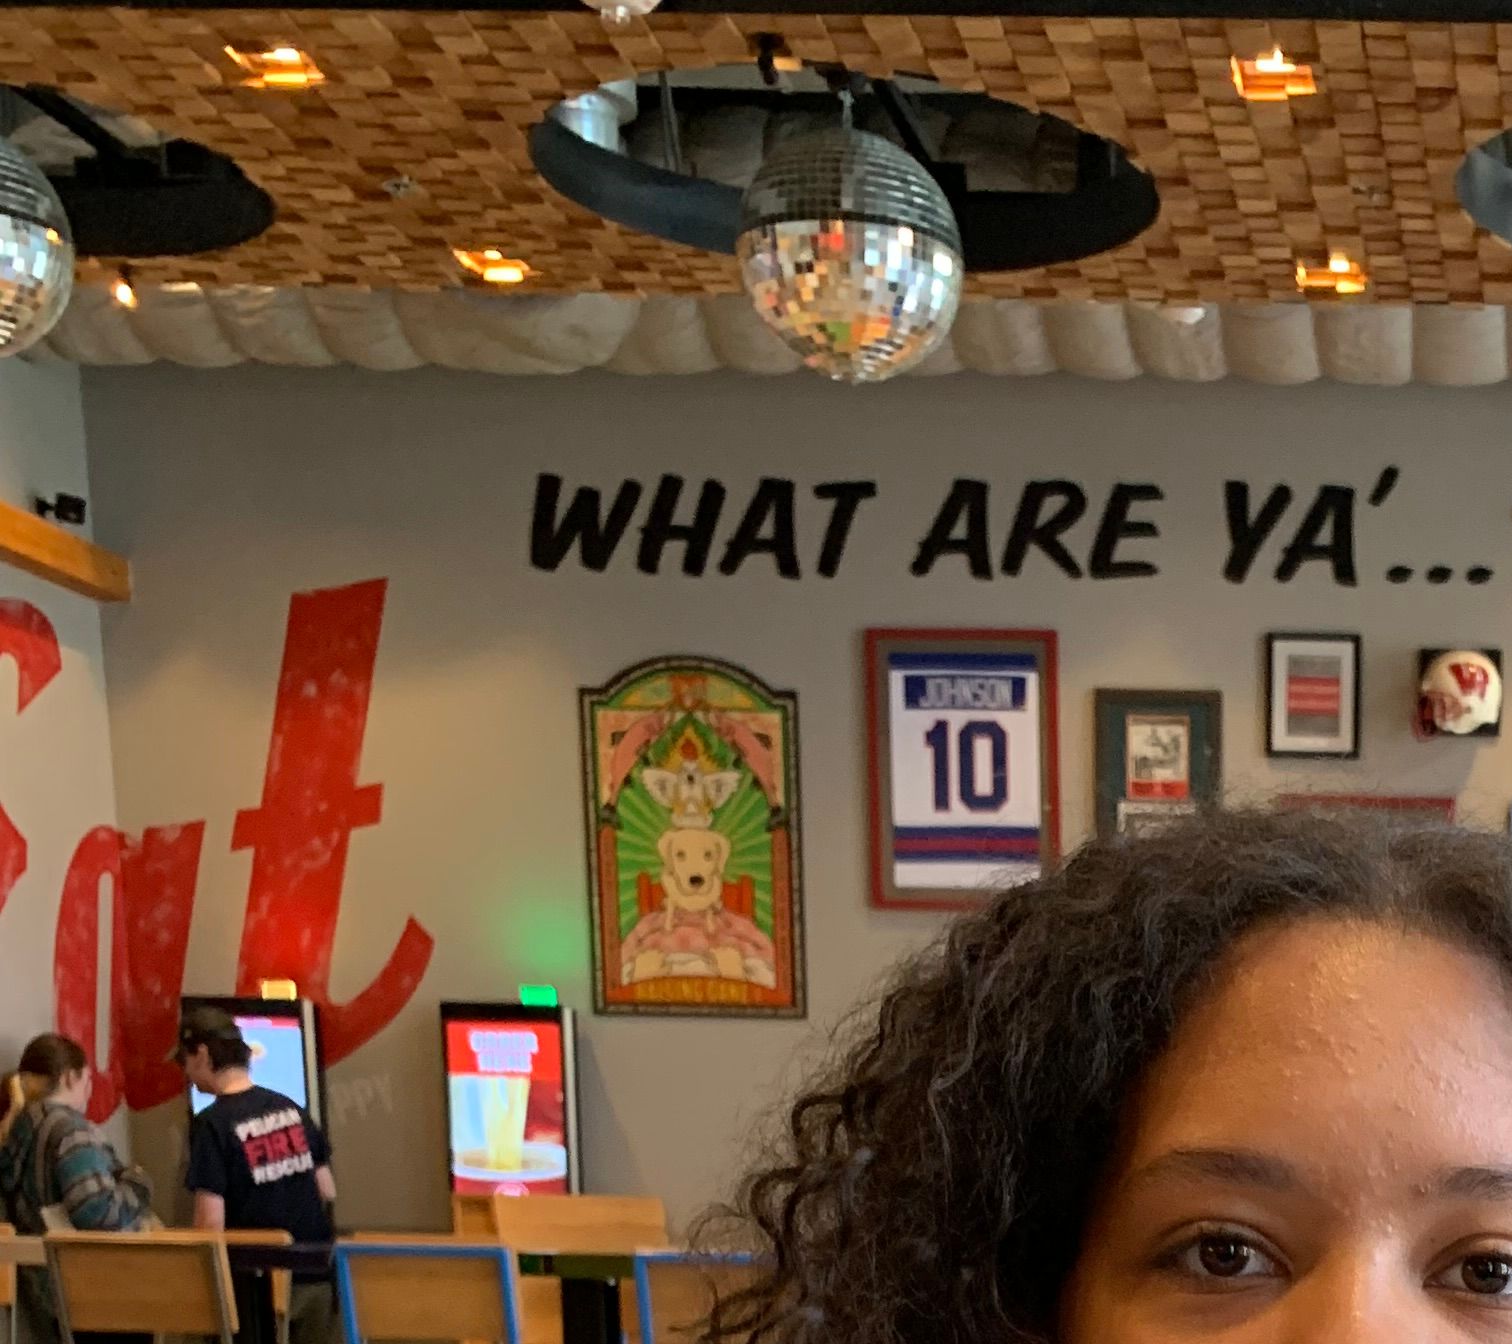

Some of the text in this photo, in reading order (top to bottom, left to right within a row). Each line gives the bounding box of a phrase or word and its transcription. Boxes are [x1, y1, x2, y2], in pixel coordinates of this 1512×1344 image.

[529, 473, 878, 578] WHAT
[911, 479, 1165, 581] ARE
[917, 675, 1014, 709] JOHNSON
[925, 719, 1008, 812] 10
[242, 1123, 311, 1168] FIRE
